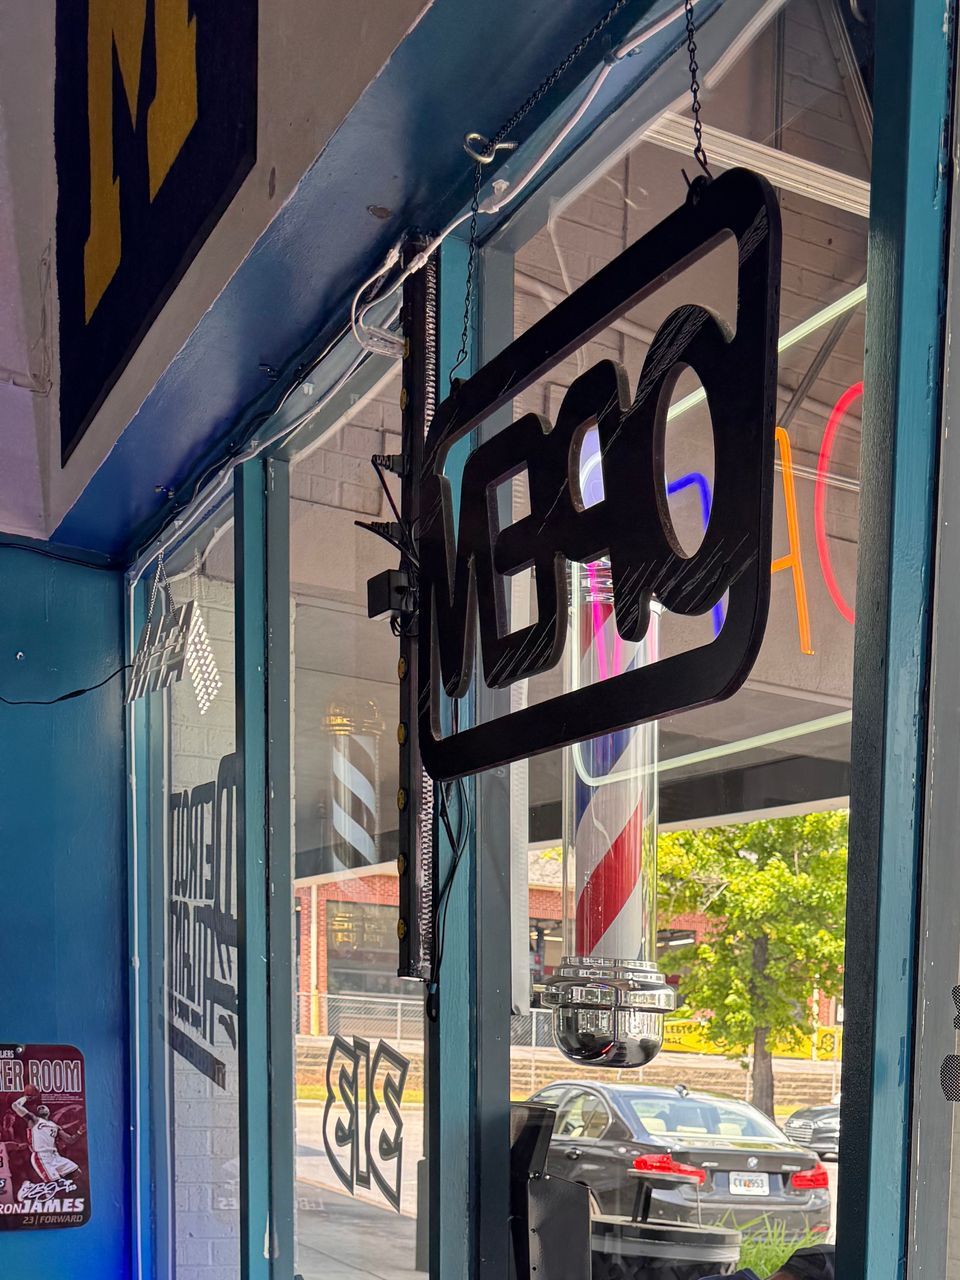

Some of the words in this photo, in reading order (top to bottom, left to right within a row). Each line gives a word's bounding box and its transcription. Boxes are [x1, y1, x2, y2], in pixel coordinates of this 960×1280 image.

[28, 1060, 82, 1093] ROOM
[21, 1198, 85, 1214] JAMES
[40, 1214, 83, 1224] FORWARD
